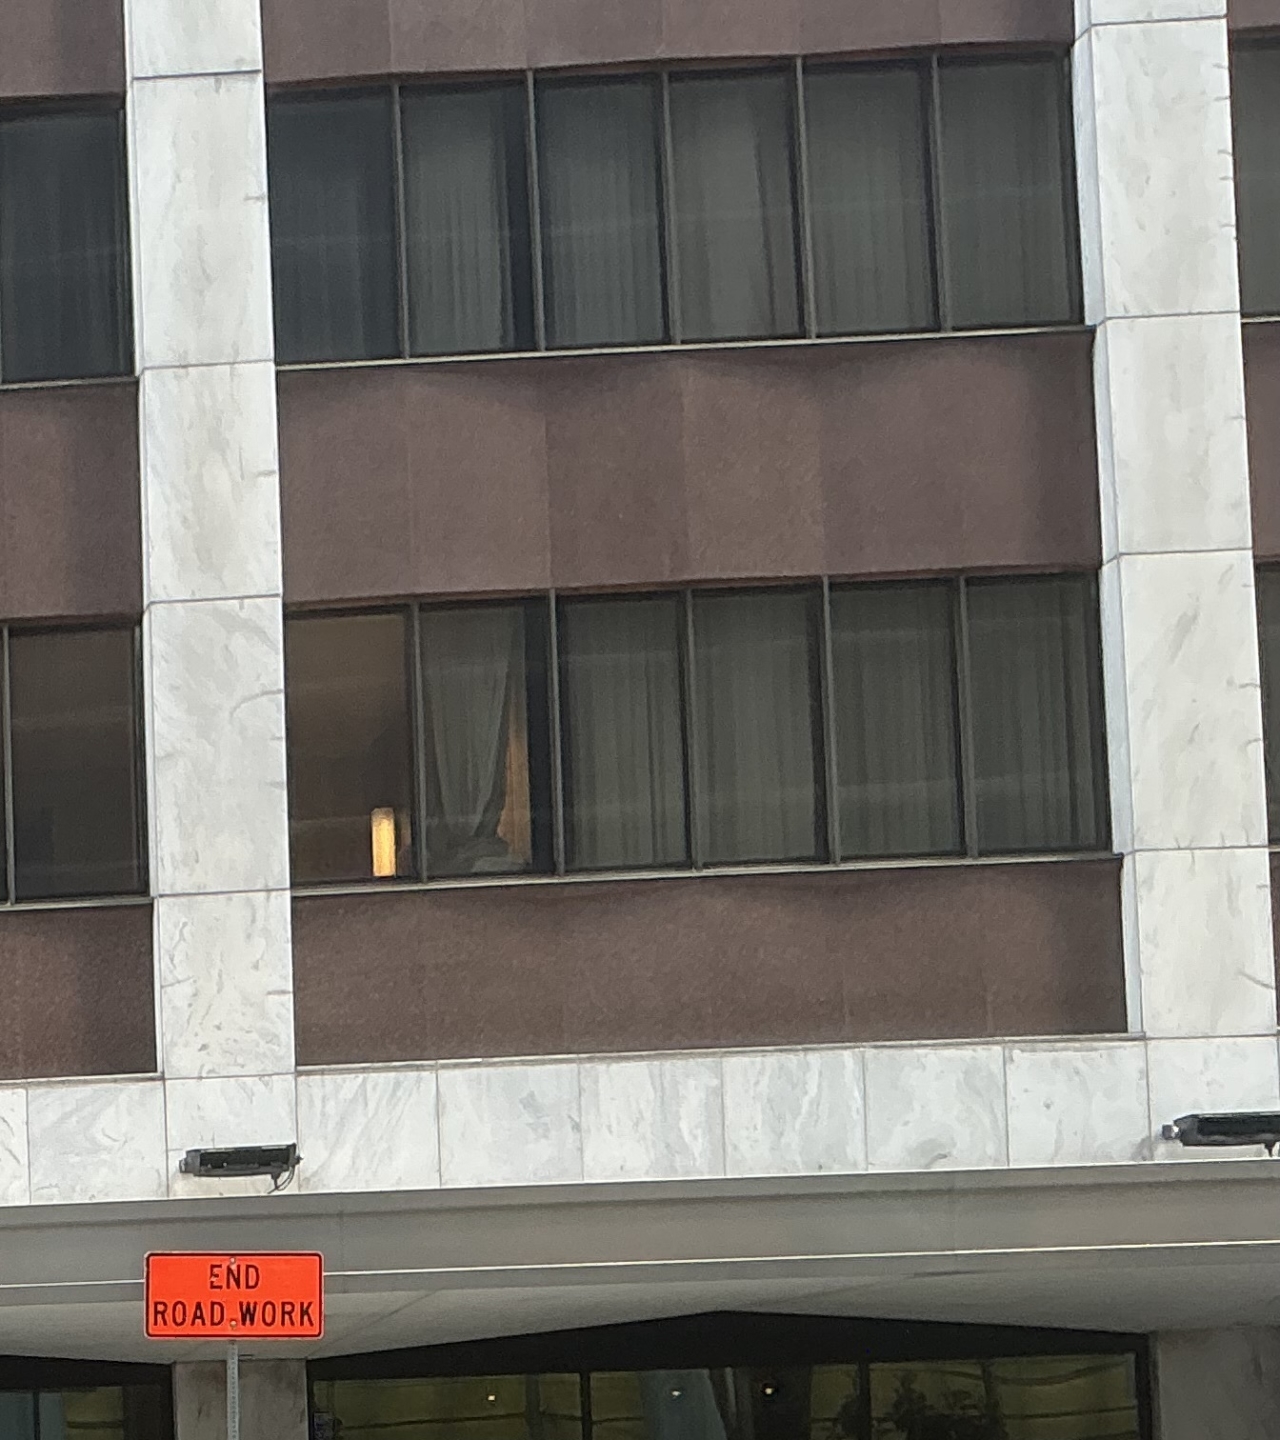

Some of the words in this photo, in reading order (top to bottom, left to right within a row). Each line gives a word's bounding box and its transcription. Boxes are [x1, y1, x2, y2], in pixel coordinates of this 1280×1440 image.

[209, 1263, 260, 1290] END
[153, 1300, 225, 1327] ROAD
[239, 1300, 315, 1327] WORK
